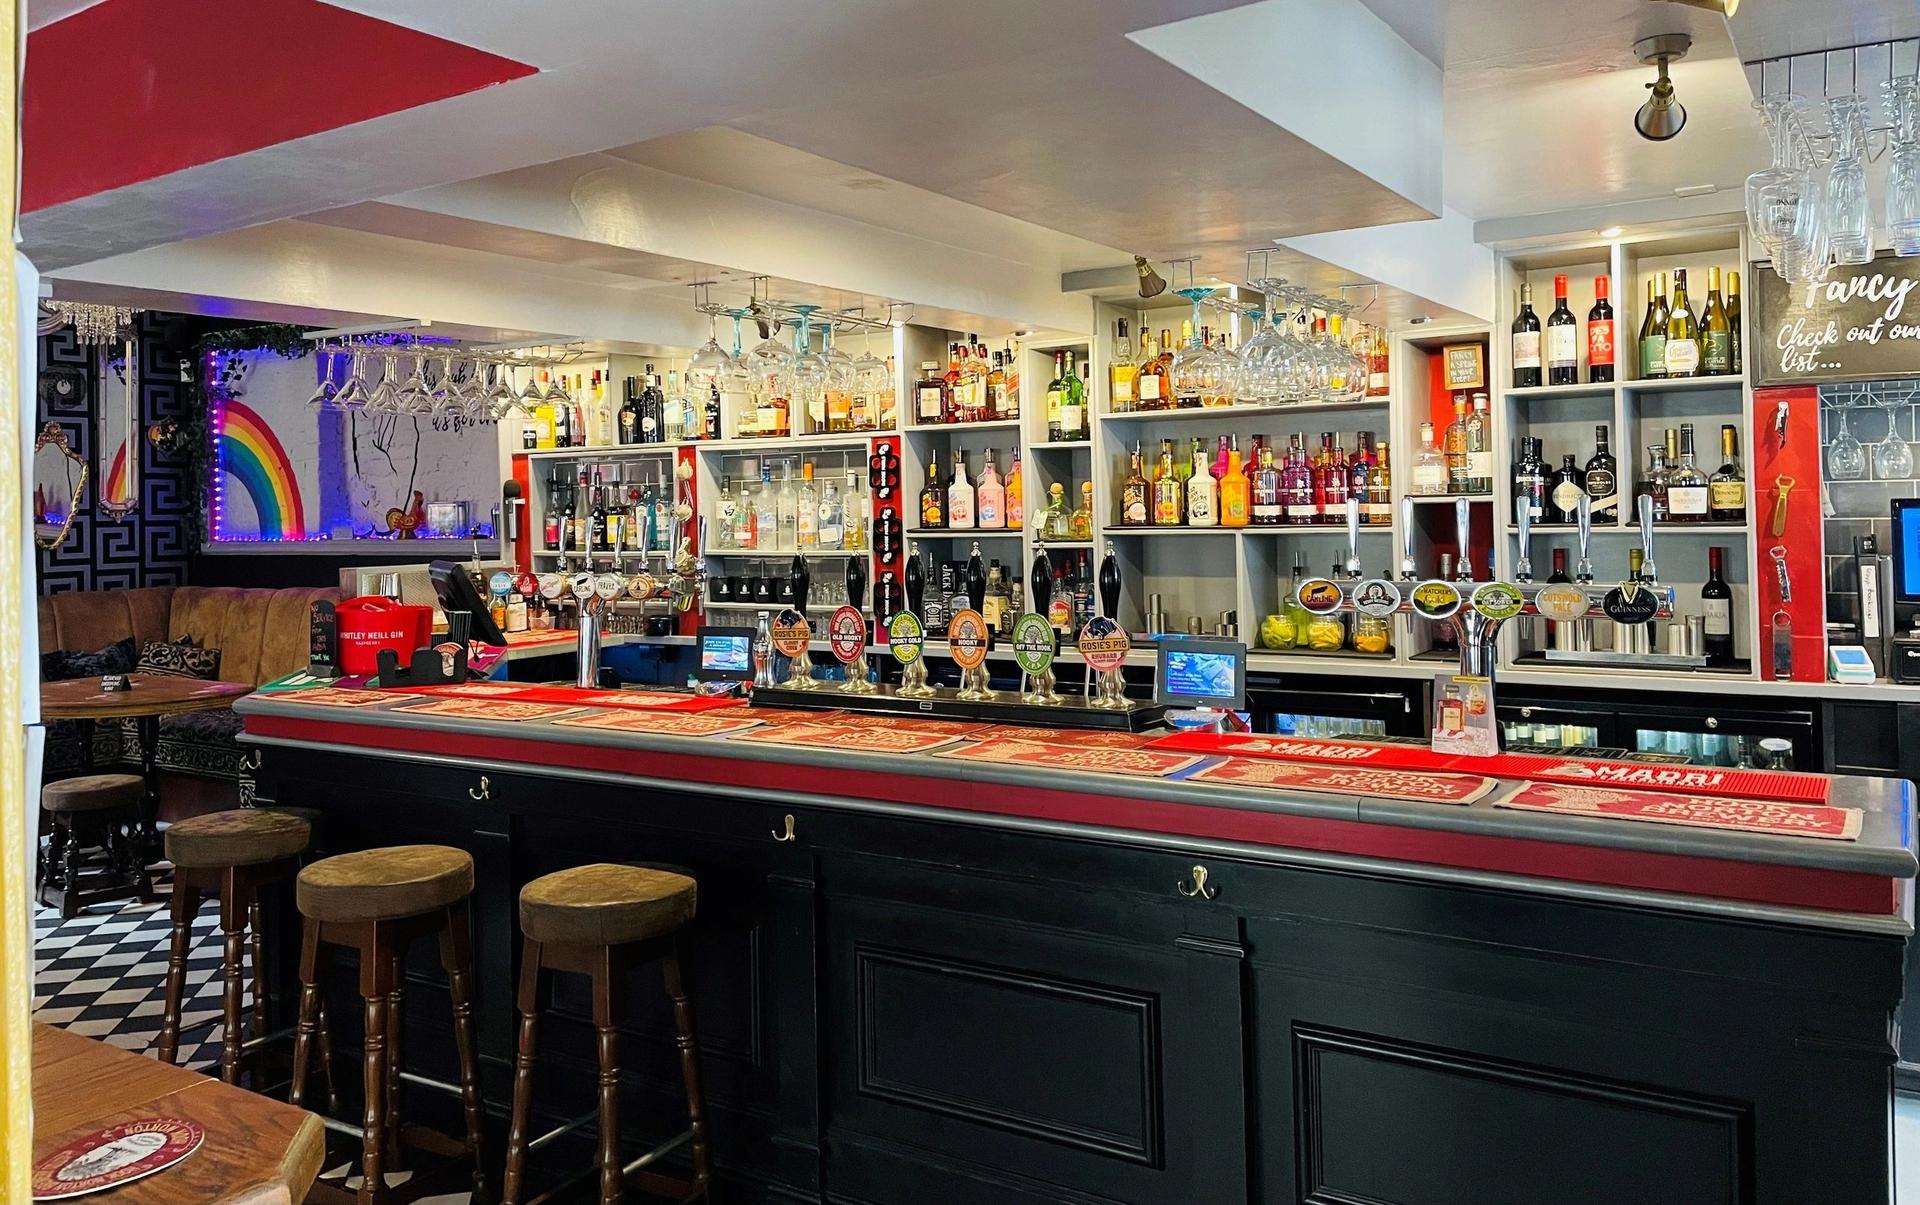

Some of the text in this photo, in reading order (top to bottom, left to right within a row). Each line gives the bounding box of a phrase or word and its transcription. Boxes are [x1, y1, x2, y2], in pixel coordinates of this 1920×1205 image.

[1803, 264, 1919, 321] Fancy
[1776, 317, 1920, 350] Check out our
[1779, 344, 1842, 373] list...
[942, 564, 954, 589] JACK
[1306, 595, 1334, 603] CARLING
[1423, 595, 1445, 604] Gold
[1553, 603, 1572, 613] PALE
[1610, 604, 1651, 613] GUINNESS
[774, 630, 797, 638] ROSIE'S
[1082, 640, 1127, 650] ROSIE'S PIG
[1328, 773, 1456, 790] NORTON
[1355, 771, 1437, 784] HOOK
[1662, 802, 1816, 821] NORTON
[1688, 798, 1790, 812] HOOK
[1640, 805, 1832, 828] BREWERY
